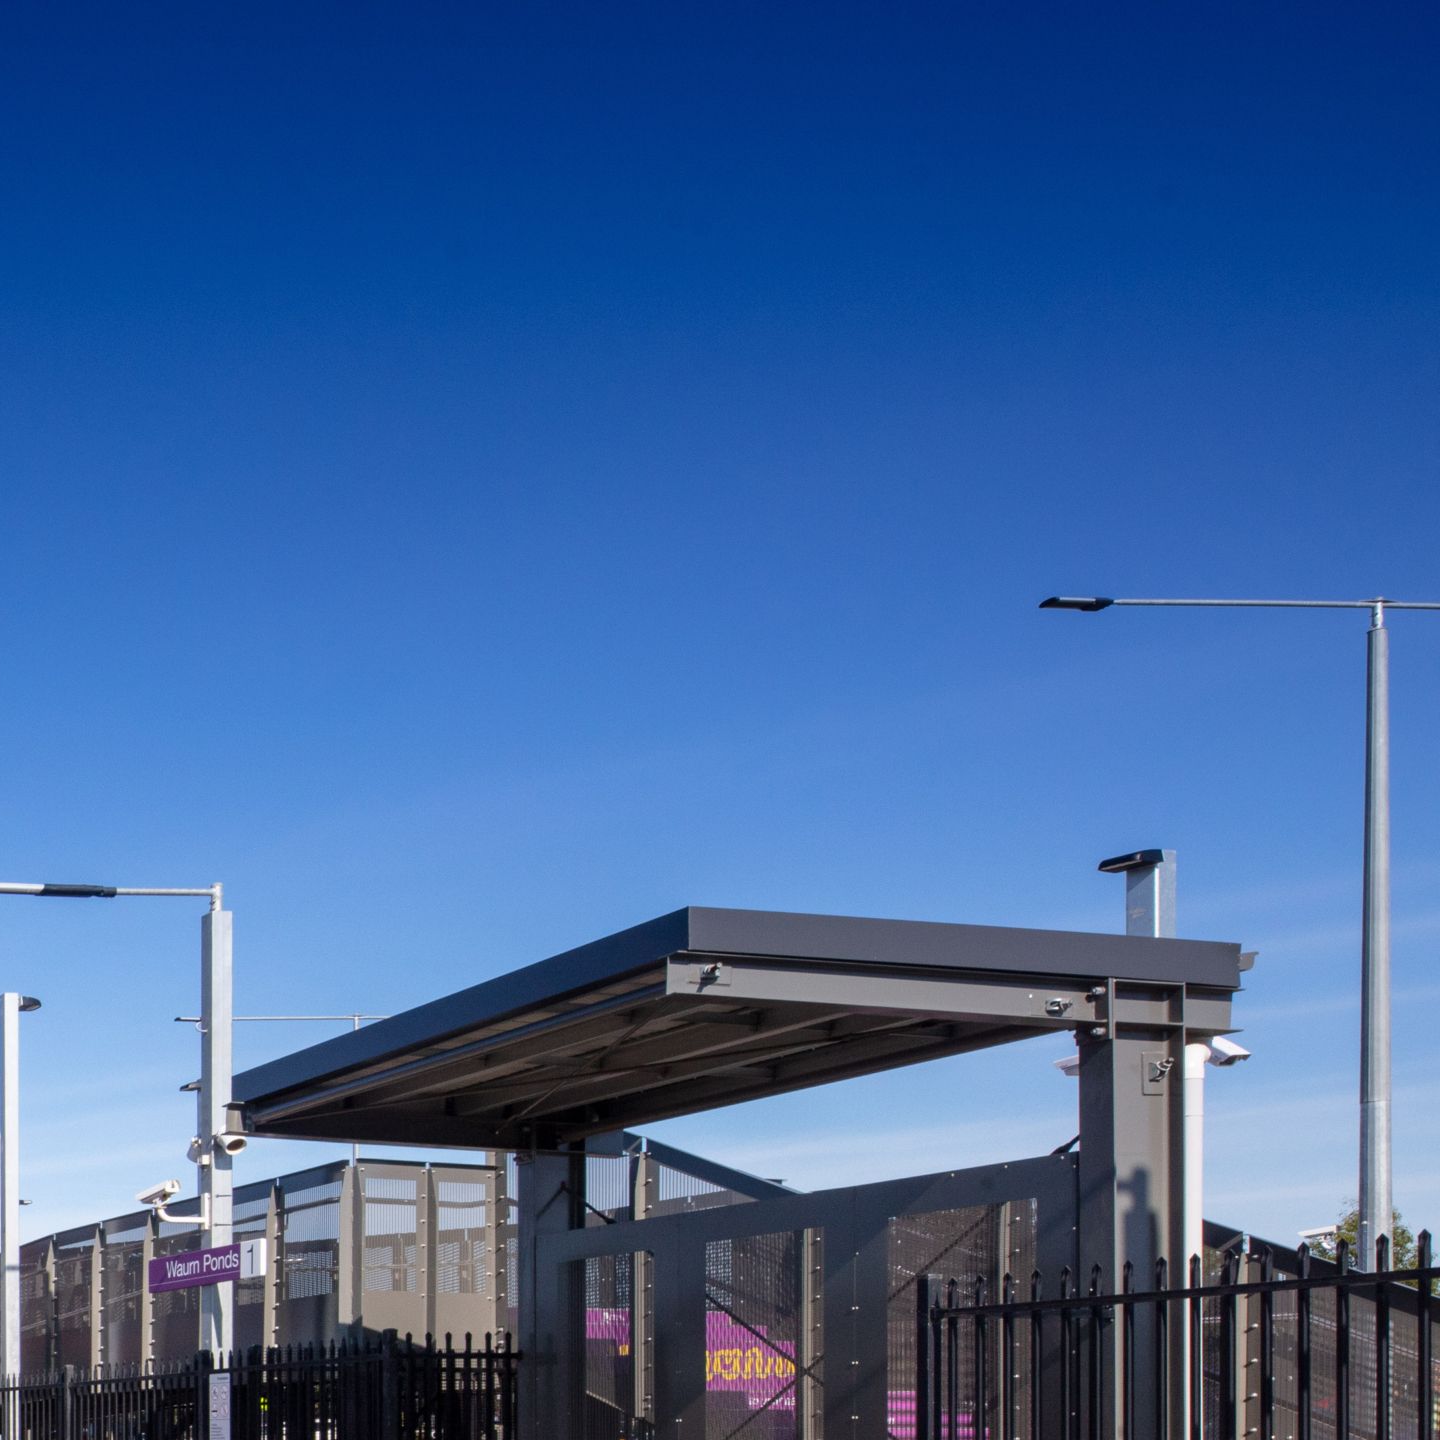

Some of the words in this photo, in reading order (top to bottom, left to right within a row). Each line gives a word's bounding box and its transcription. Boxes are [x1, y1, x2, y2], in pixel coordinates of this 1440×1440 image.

[166, 1259, 200, 1279] Waurn
[203, 1249, 239, 1272] Ponds
[246, 1243, 254, 1275] 1
